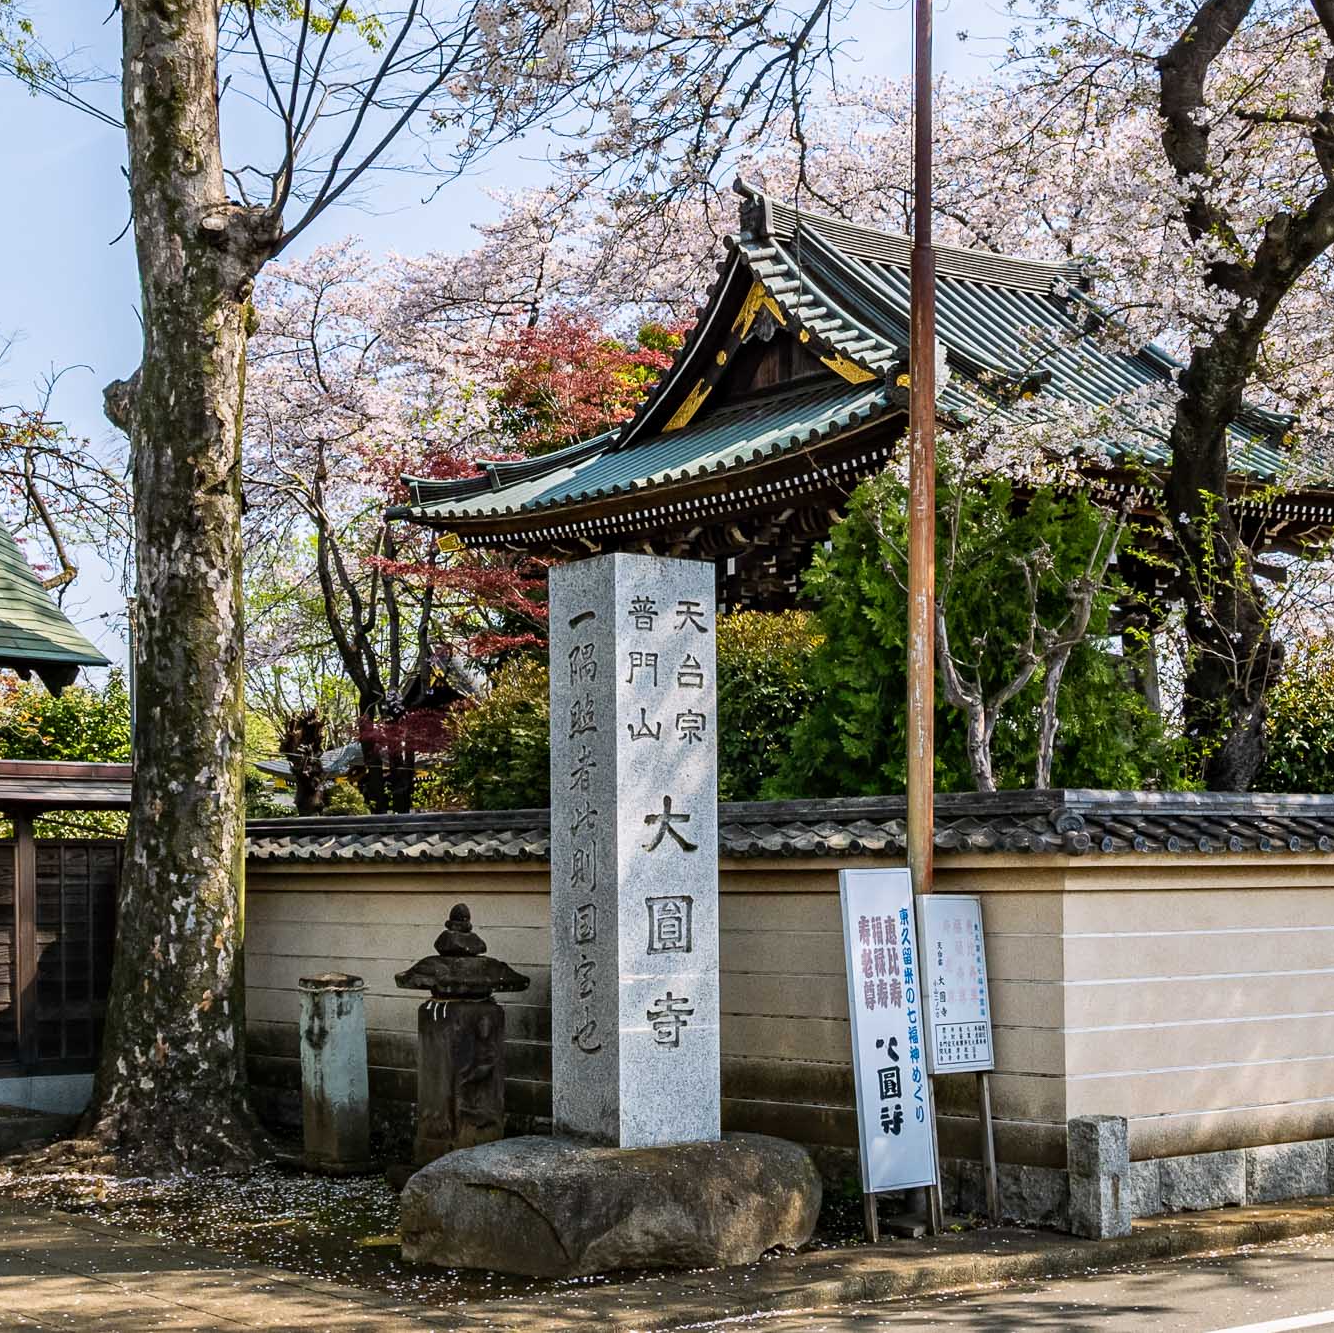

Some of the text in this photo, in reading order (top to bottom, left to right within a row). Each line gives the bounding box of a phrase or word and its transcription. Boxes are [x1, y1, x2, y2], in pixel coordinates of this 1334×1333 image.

[624, 595, 662, 743] 普門山
[673, 599, 709, 746] 天台宗
[641, 794, 699, 1050] 大圓寺
[898, 907, 925, 1123] 東久留米の七福神めぐり
